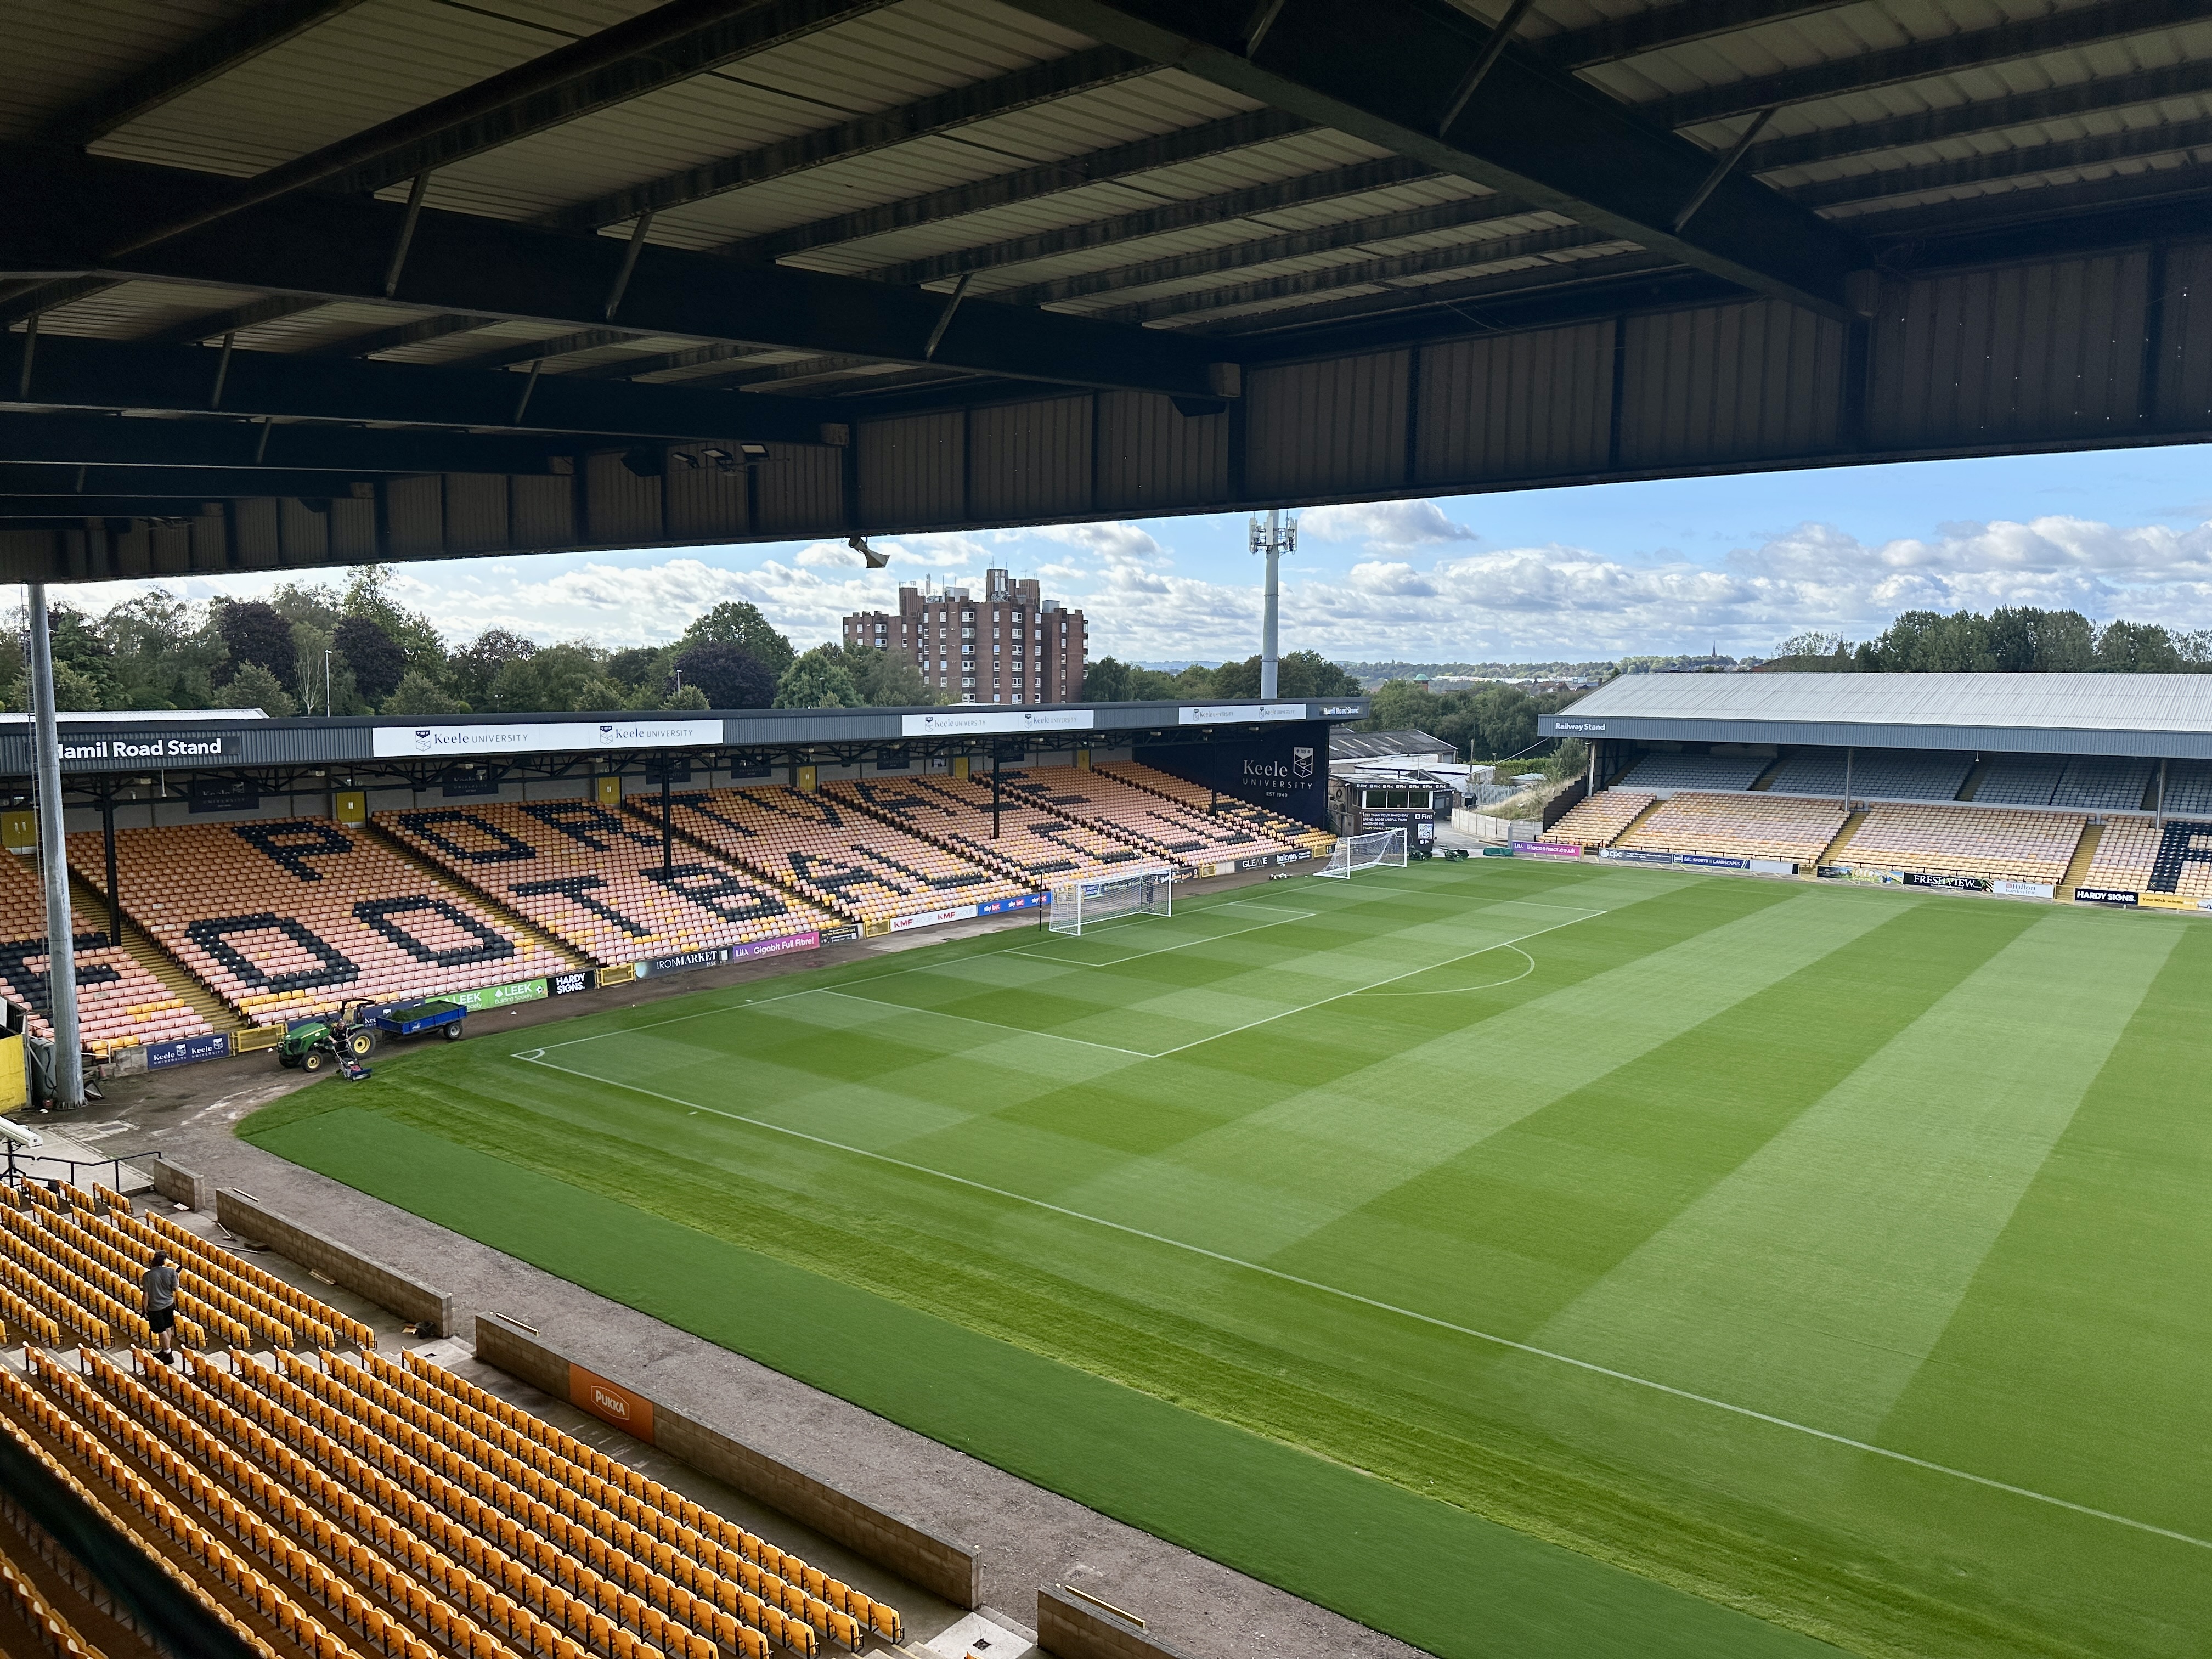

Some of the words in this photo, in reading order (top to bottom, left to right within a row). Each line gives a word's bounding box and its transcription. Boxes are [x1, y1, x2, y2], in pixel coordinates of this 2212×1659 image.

[1347, 706, 1359, 714] Stand
[935, 719, 954, 727] Keele
[1034, 716, 1049, 724] Keele
[1555, 723, 1583, 732] Railway
[616, 728, 645, 738] Keele
[647, 729, 693, 737] UNIVERSITY
[434, 733, 469, 744] Keele
[472, 734, 528, 743] UNIVERSITY
[113, 740, 163, 757] Road
[168, 738, 222, 756] Stand
[1243, 759, 1288, 777] Keele
[1243, 778, 1312, 790] UNIVERSITY
[1242, 857, 1267, 868] GLEAVE
[1913, 874, 1976, 888] FRESHVIEW
[2077, 891, 2107, 900] HARDY
[753, 944, 781, 955] Gigabit
[781, 940, 794, 950] Full
[795, 937, 814, 948] Fibre!
[556, 973, 586, 986] HARDY
[505, 983, 532, 997] LEEK
[453, 992, 482, 1005] LEEK
[515, 994, 533, 1002] Society
[192, 1046, 212, 1054] Keele
[192, 1050, 224, 1058] UNIVERSITY
[154, 1052, 176, 1061] Keele
[154, 1057, 187, 1065] UNIVERSITY
[595, 1390, 625, 1415] PUKKA
